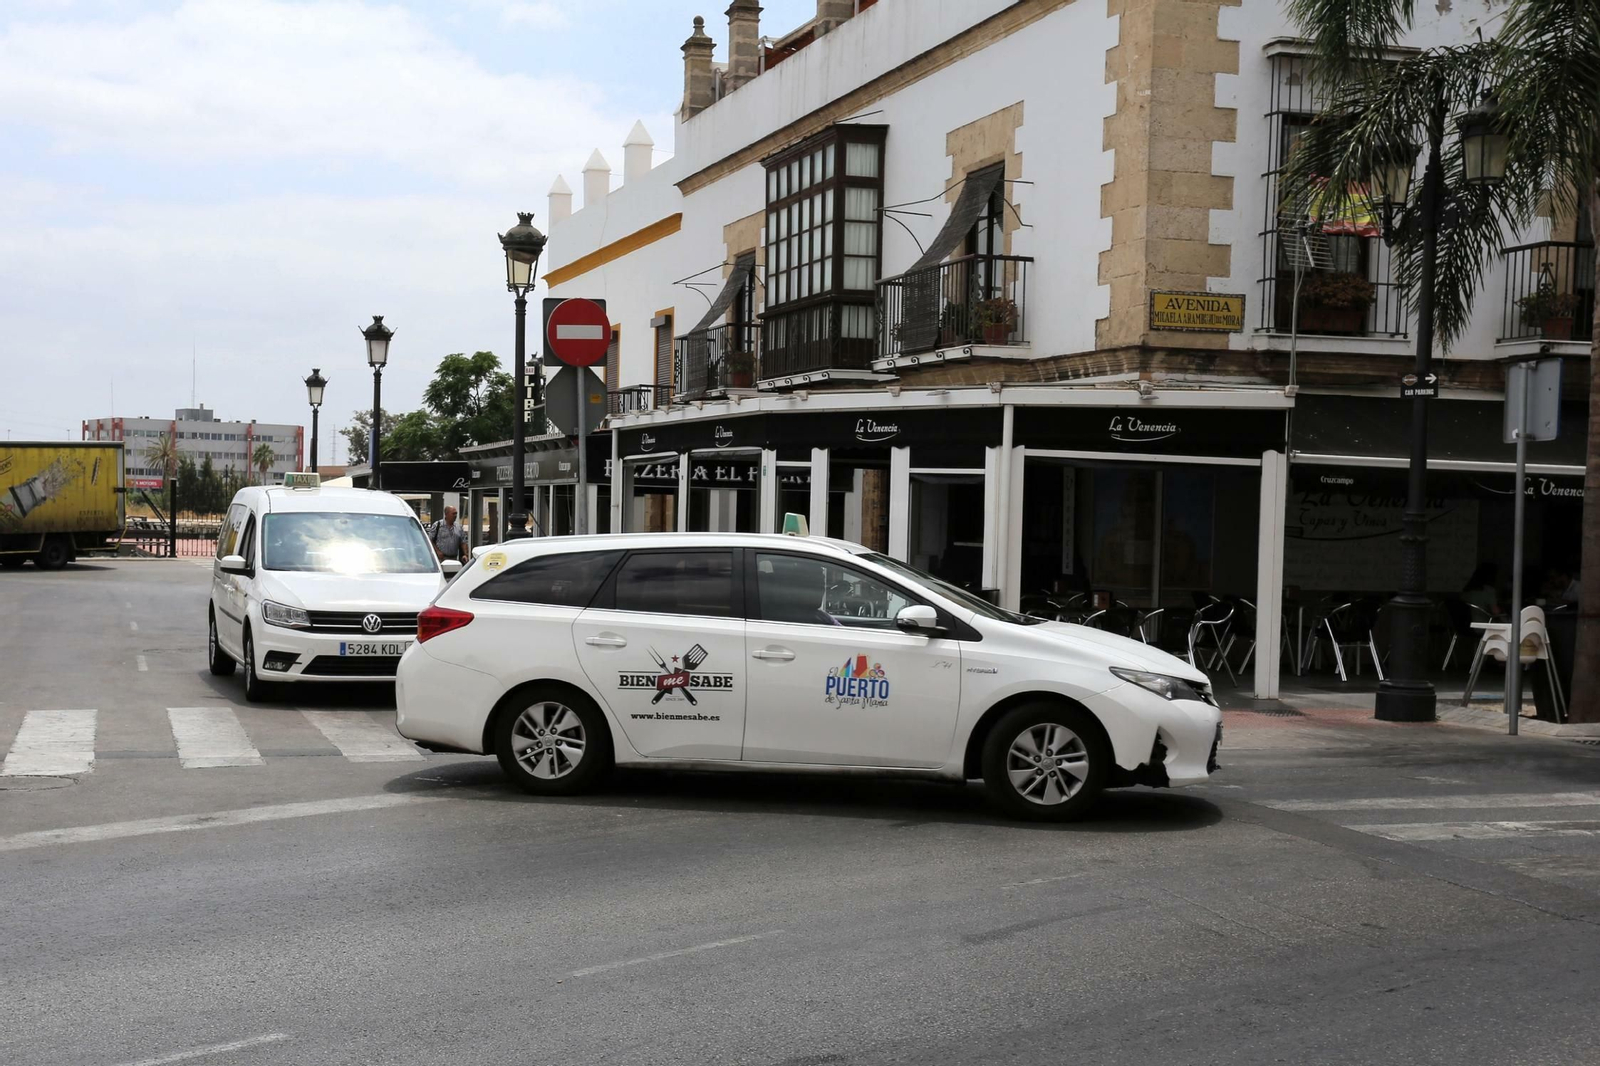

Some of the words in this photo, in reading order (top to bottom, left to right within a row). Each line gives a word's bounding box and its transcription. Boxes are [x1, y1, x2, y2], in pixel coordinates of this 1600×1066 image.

[1165, 298, 1231, 312] AVENIDA
[1223, 315, 1240, 326] MORA
[855, 418, 864, 432] La
[867, 419, 898, 432] Venencia
[1108, 416, 1122, 431] La
[1127, 416, 1177, 431] Venencia
[715, 466, 742, 480] EL
[1320, 475, 1354, 486] Cruzcampo
[348, 643, 377, 655] 5284
[381, 643, 402, 655] KDL
[619, 675, 657, 687] BIEN
[663, 676, 684, 686] me
[690, 676, 733, 688] SABE
[825, 676, 889, 699] PUERTO
[825, 693, 835, 703] de
[631, 713, 720, 721] www.bienmesabe.es
